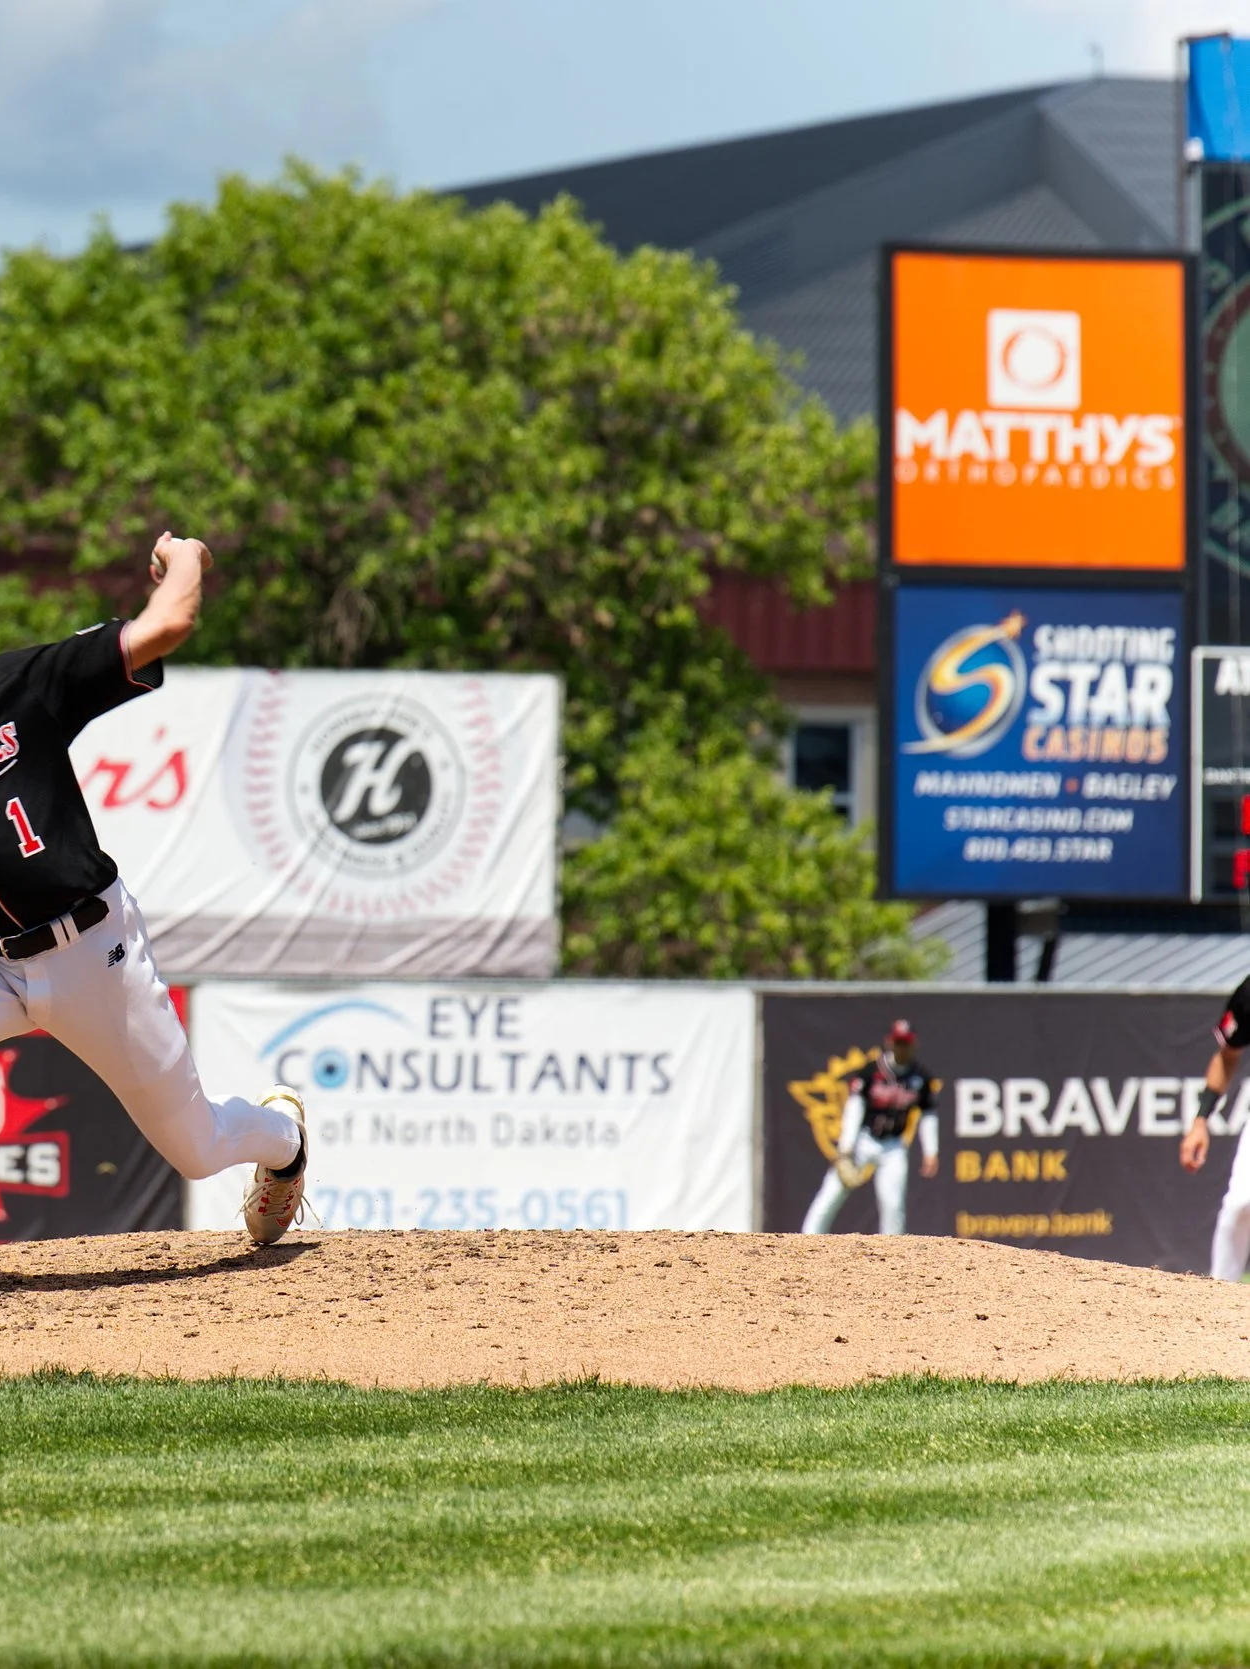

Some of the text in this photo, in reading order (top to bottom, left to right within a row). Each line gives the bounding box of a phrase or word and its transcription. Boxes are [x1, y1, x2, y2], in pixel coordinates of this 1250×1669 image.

[895, 408, 1177, 467] MATTHYS
[895, 460, 1176, 490] ORTHOPAEDICS
[1034, 625, 1176, 664] SHOOTING
[1027, 662, 1173, 727] STAR
[1022, 727, 1169, 763] CASINOS
[5, 797, 46, 859] 1
[428, 998, 523, 1040] EYE
[276, 1050, 673, 1095] CONSULTANTS
[320, 1114, 621, 1149] of North Dakota
[955, 1150, 1068, 1182] BANK
[314, 1188, 628, 1229] 701-235-0561
[956, 1210, 1113, 1239] bravera.bank
